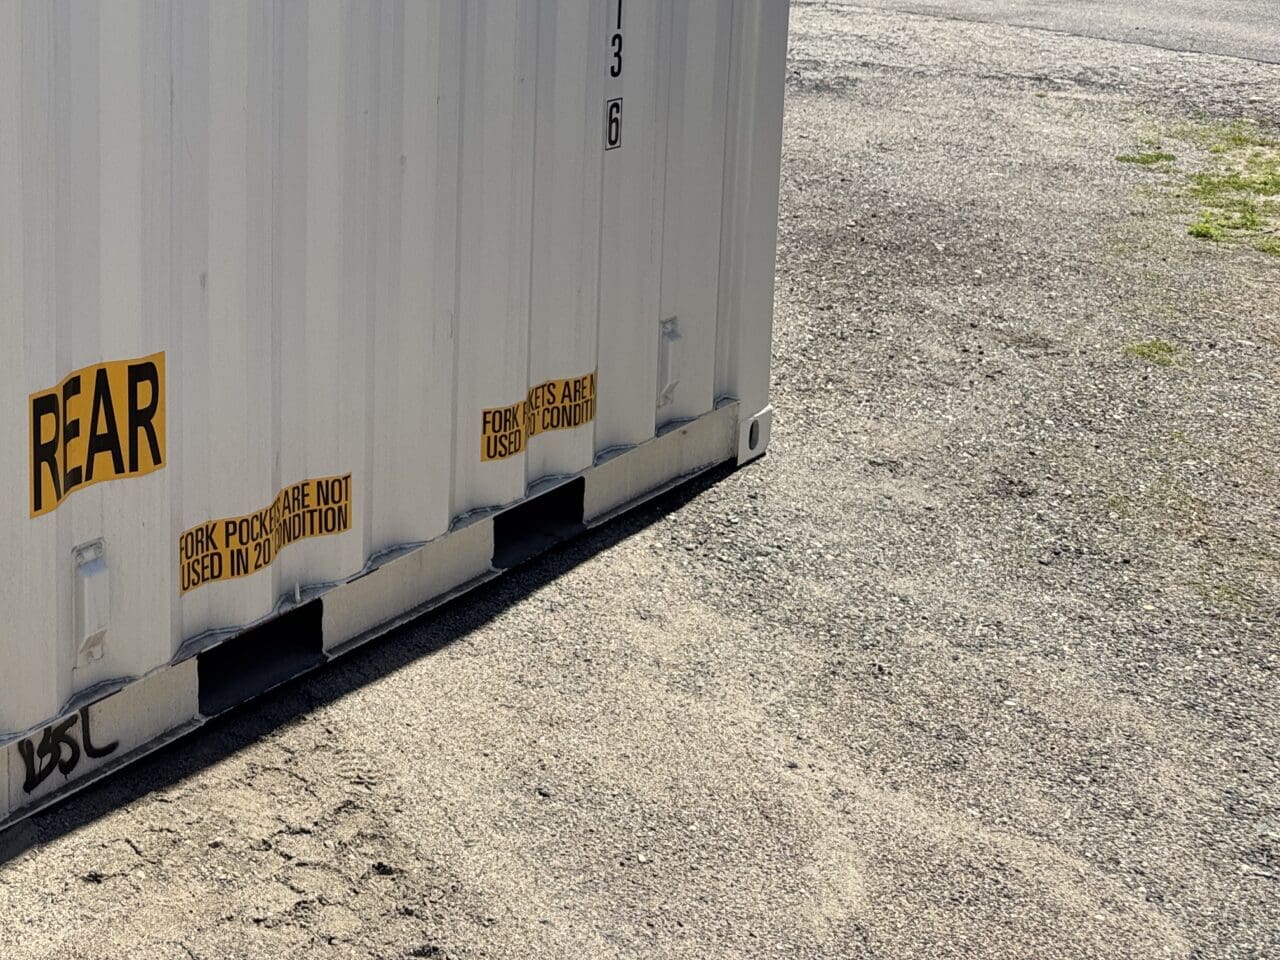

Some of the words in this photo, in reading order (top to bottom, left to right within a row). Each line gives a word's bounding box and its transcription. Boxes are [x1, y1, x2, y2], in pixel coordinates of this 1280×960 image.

[608, 102, 620, 146] 6
[33, 362, 162, 512] REAR
[482, 404, 519, 434] FORK
[561, 377, 587, 403] ARE
[487, 430, 520, 458] USED
[542, 399, 594, 430] CONDITI
[180, 522, 217, 565] FORK
[225, 498, 280, 548] POCKETS
[282, 482, 310, 518] ARE
[316, 475, 351, 507] NOT
[181, 552, 222, 591] USED
[230, 547, 249, 576] IN
[275, 504, 348, 553] CONDITION
